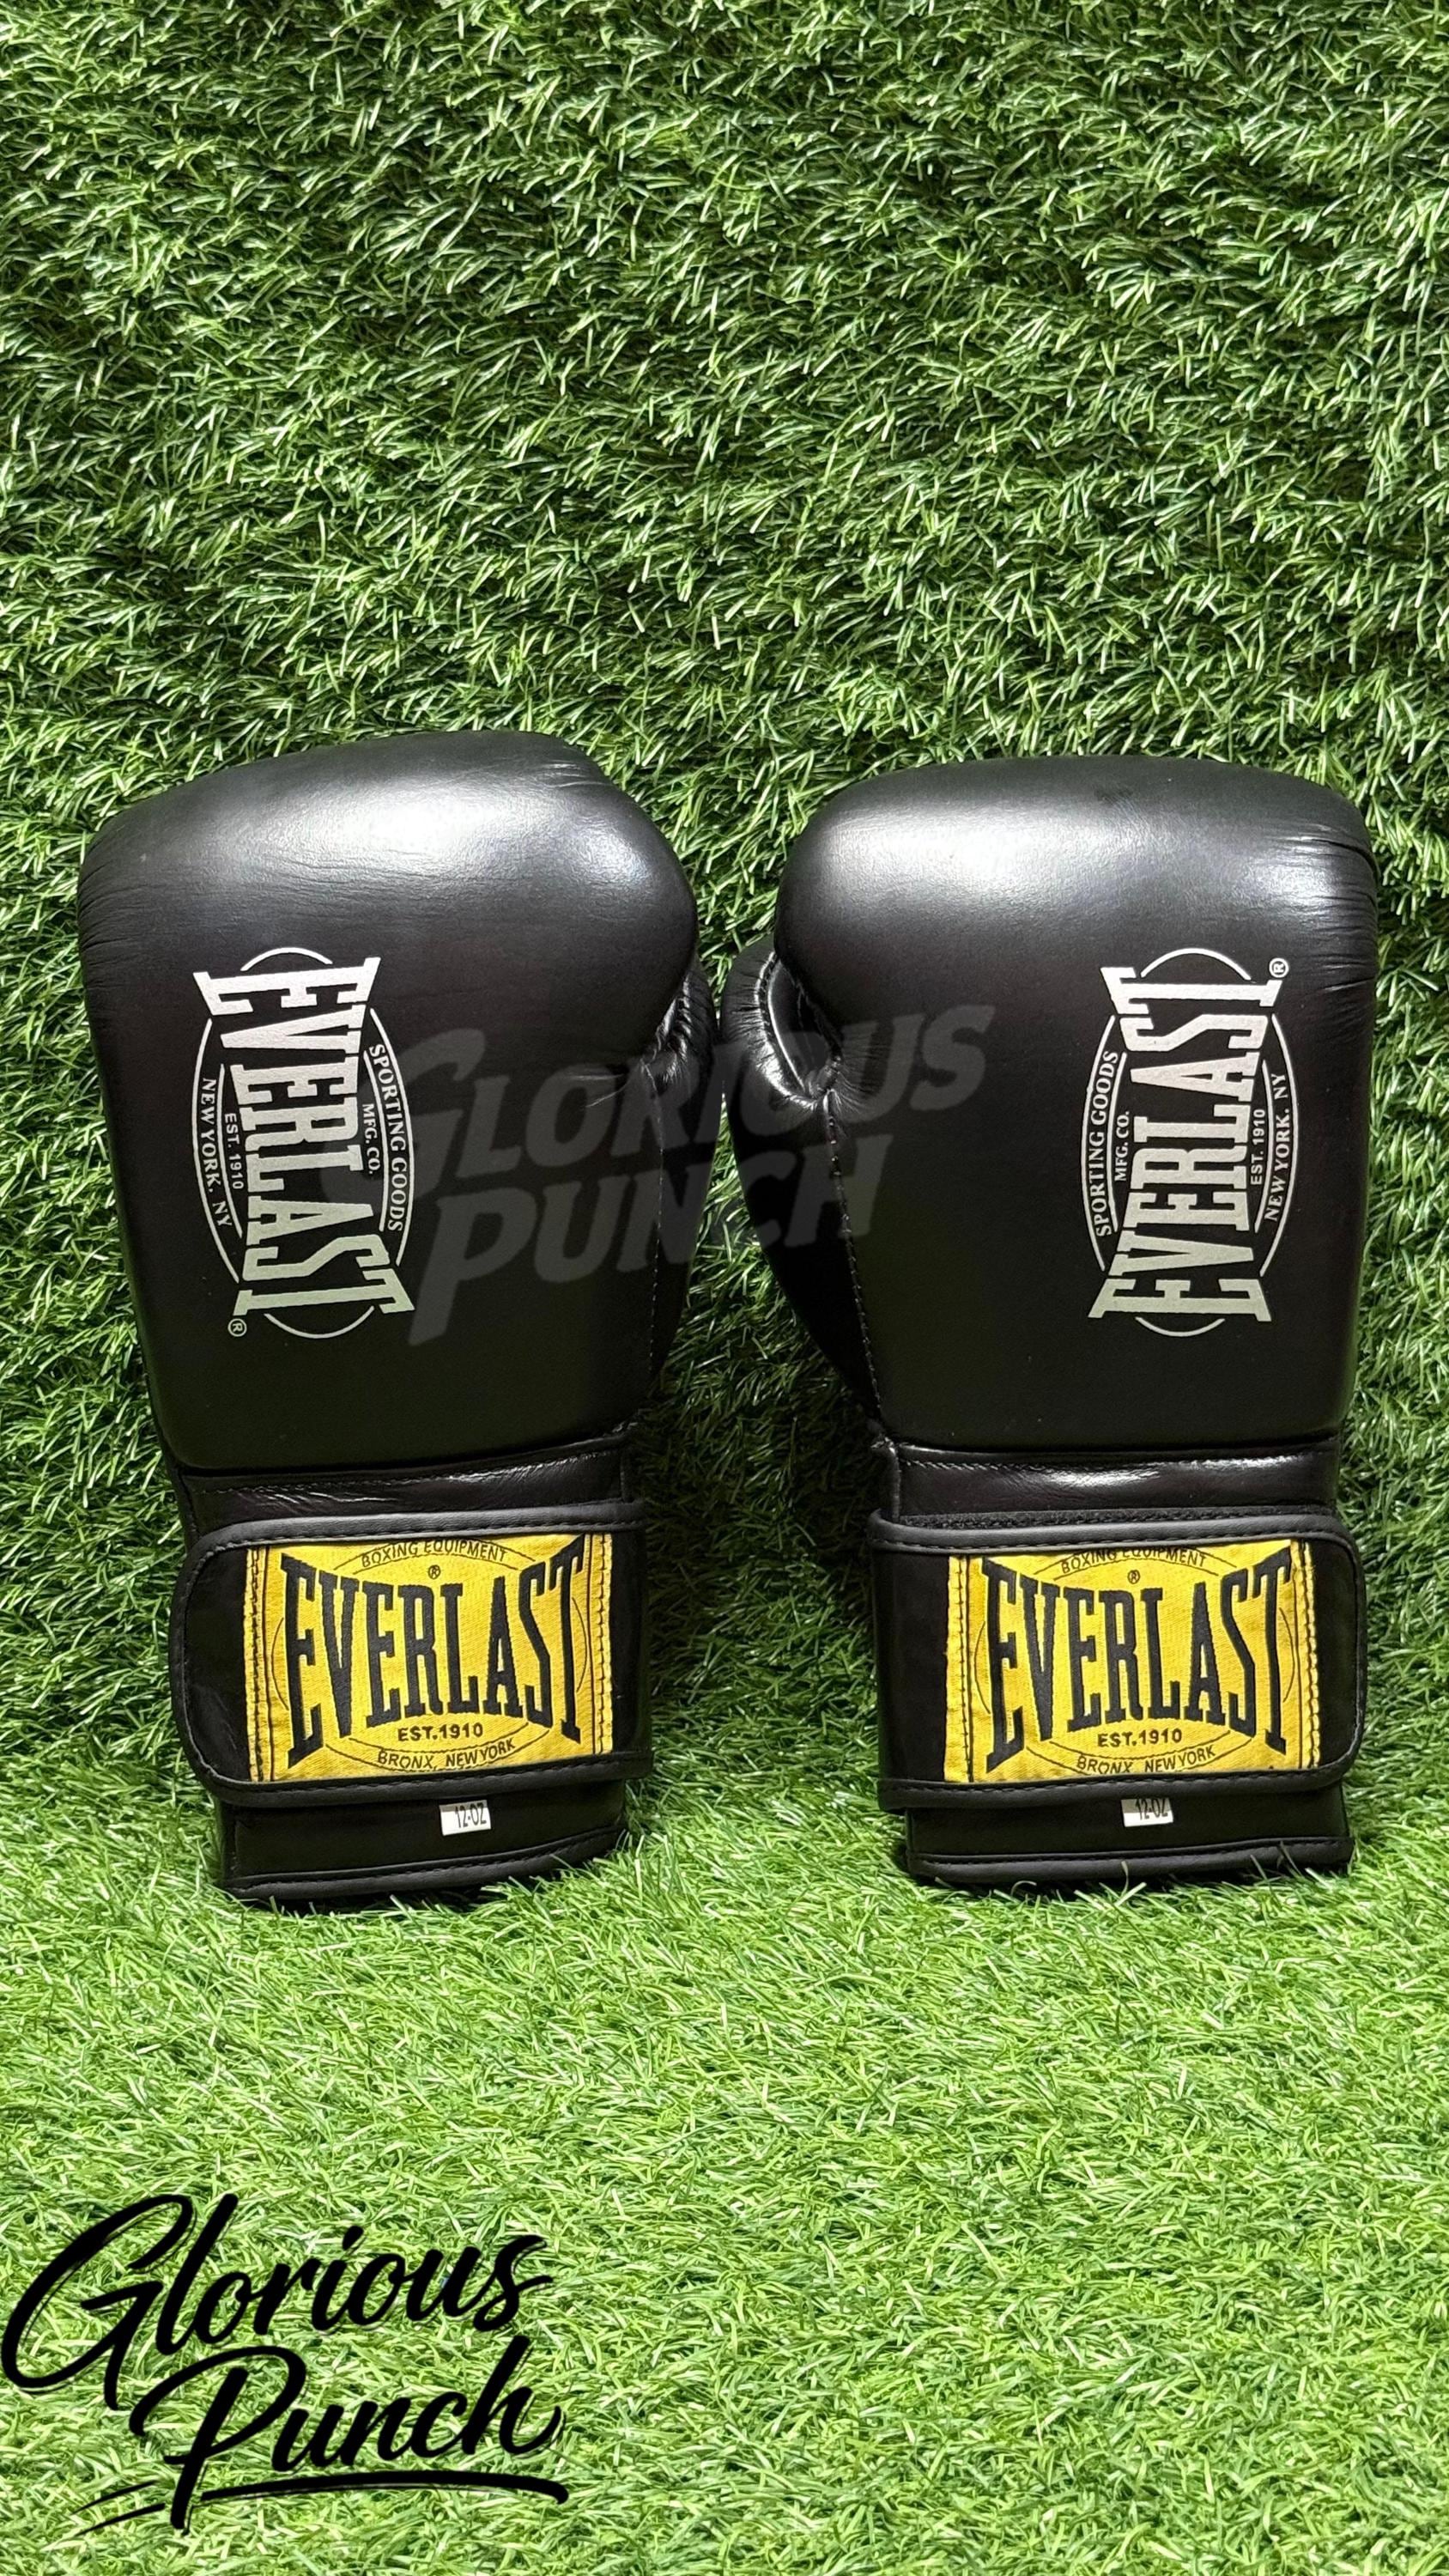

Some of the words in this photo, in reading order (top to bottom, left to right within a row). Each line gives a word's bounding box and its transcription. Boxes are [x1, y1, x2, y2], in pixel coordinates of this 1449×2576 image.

[369, 1043, 406, 1151] SPORTING
[1090, 1051, 1119, 1126] GOODS
[1270, 1073, 1288, 1100] NY
[192, 957, 415, 1315] EVERLAST
[224, 1113, 240, 1148] EST.
[361, 1103, 378, 1144] MFG.
[1088, 967, 1282, 1321] EVERLAST
[1116, 1110, 1131, 1139] CO.
[1252, 1109, 1266, 1145] 1910
[200, 1078, 217, 1125] NEW
[212, 1200, 233, 1227] NY
[228, 1153, 245, 1190] 1910
[367, 1146, 381, 1175] CO.
[1114, 1142, 1129, 1182] MFG.
[1250, 1151, 1264, 1185] EST.
[387, 1157, 408, 1231] GOODS
[1088, 1131, 1112, 1236] SPORTING
[1264, 1176, 1286, 1221] NEW
[361, 1541, 419, 1567] BOXING
[423, 1539, 507, 1562] EQUIPMENT
[1061, 1550, 1117, 1574] BOXING
[281, 1533, 585, 1769] EVERLAST
[982, 1545, 1291, 1773] EVERLAST
